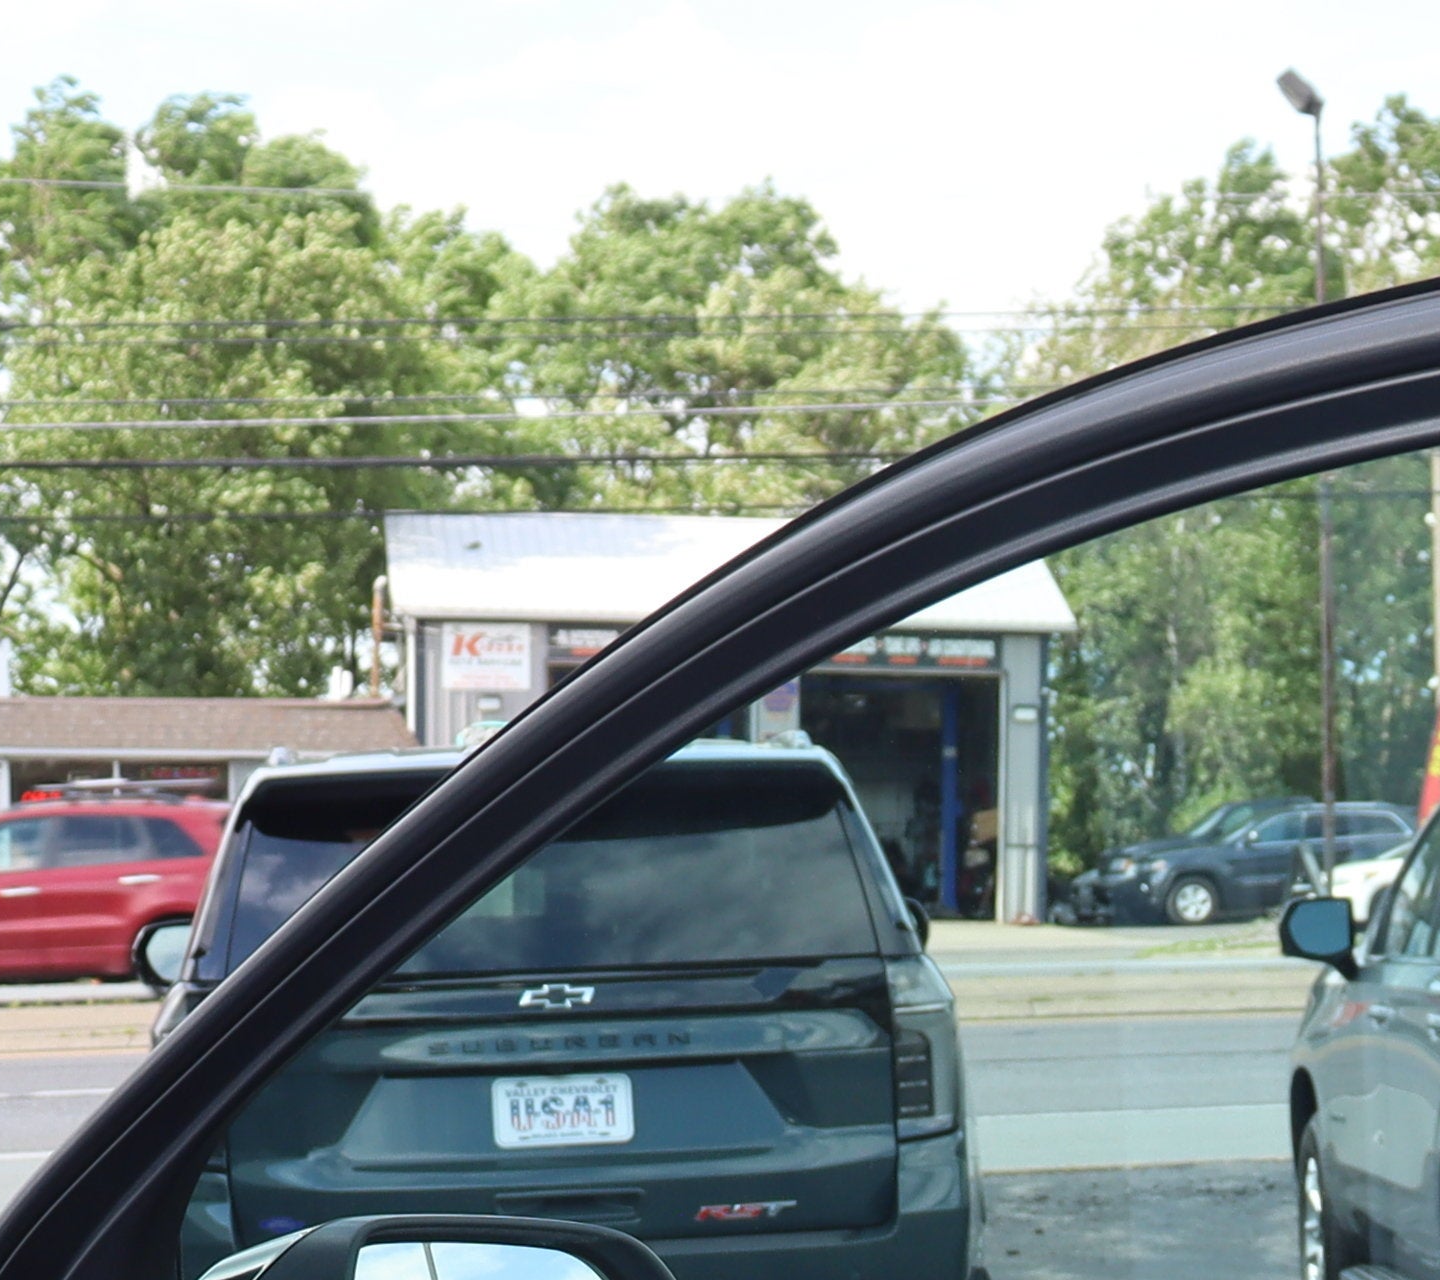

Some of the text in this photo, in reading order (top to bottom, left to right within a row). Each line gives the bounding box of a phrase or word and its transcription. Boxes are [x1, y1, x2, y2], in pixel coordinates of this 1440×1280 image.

[428, 1031, 691, 1055] SUBURBAN
[505, 1084, 617, 1097] VALLEY CHEVROLET
[695, 1200, 797, 1221] RST
